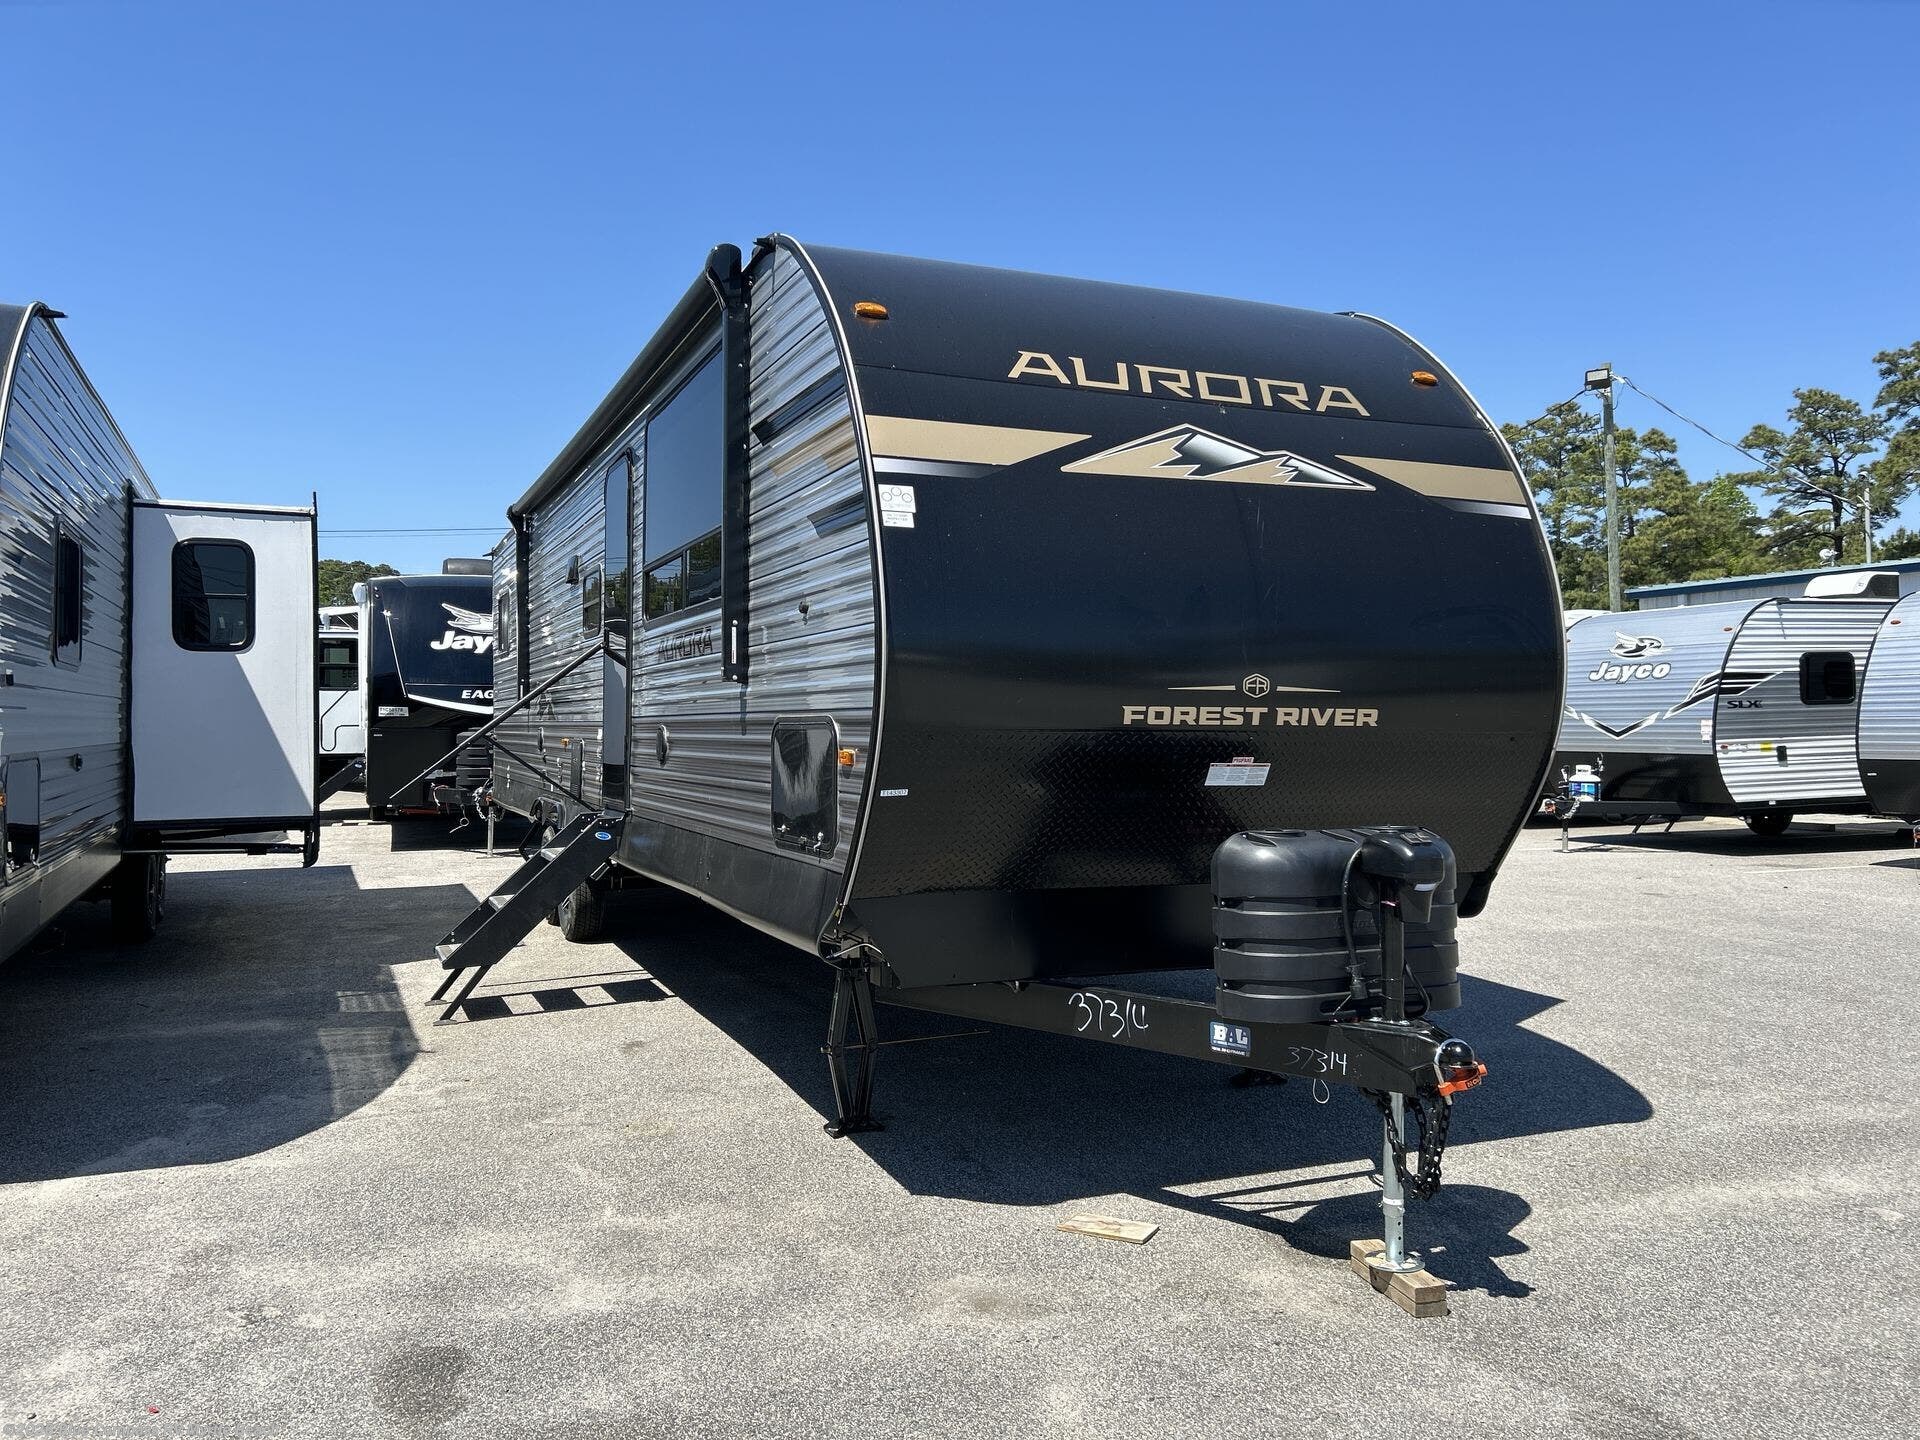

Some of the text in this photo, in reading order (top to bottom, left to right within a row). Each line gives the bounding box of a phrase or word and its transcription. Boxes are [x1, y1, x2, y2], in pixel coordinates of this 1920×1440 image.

[1008, 350, 1370, 417] AURORA
[658, 626, 713, 661] AURORA
[1588, 661, 1672, 685] Jayco
[1122, 705, 1379, 727] FOREST RIVER
[1727, 699, 1763, 709] SLX
[1068, 992, 1149, 1038] 37314
[1283, 1046, 1347, 1076] 37314
